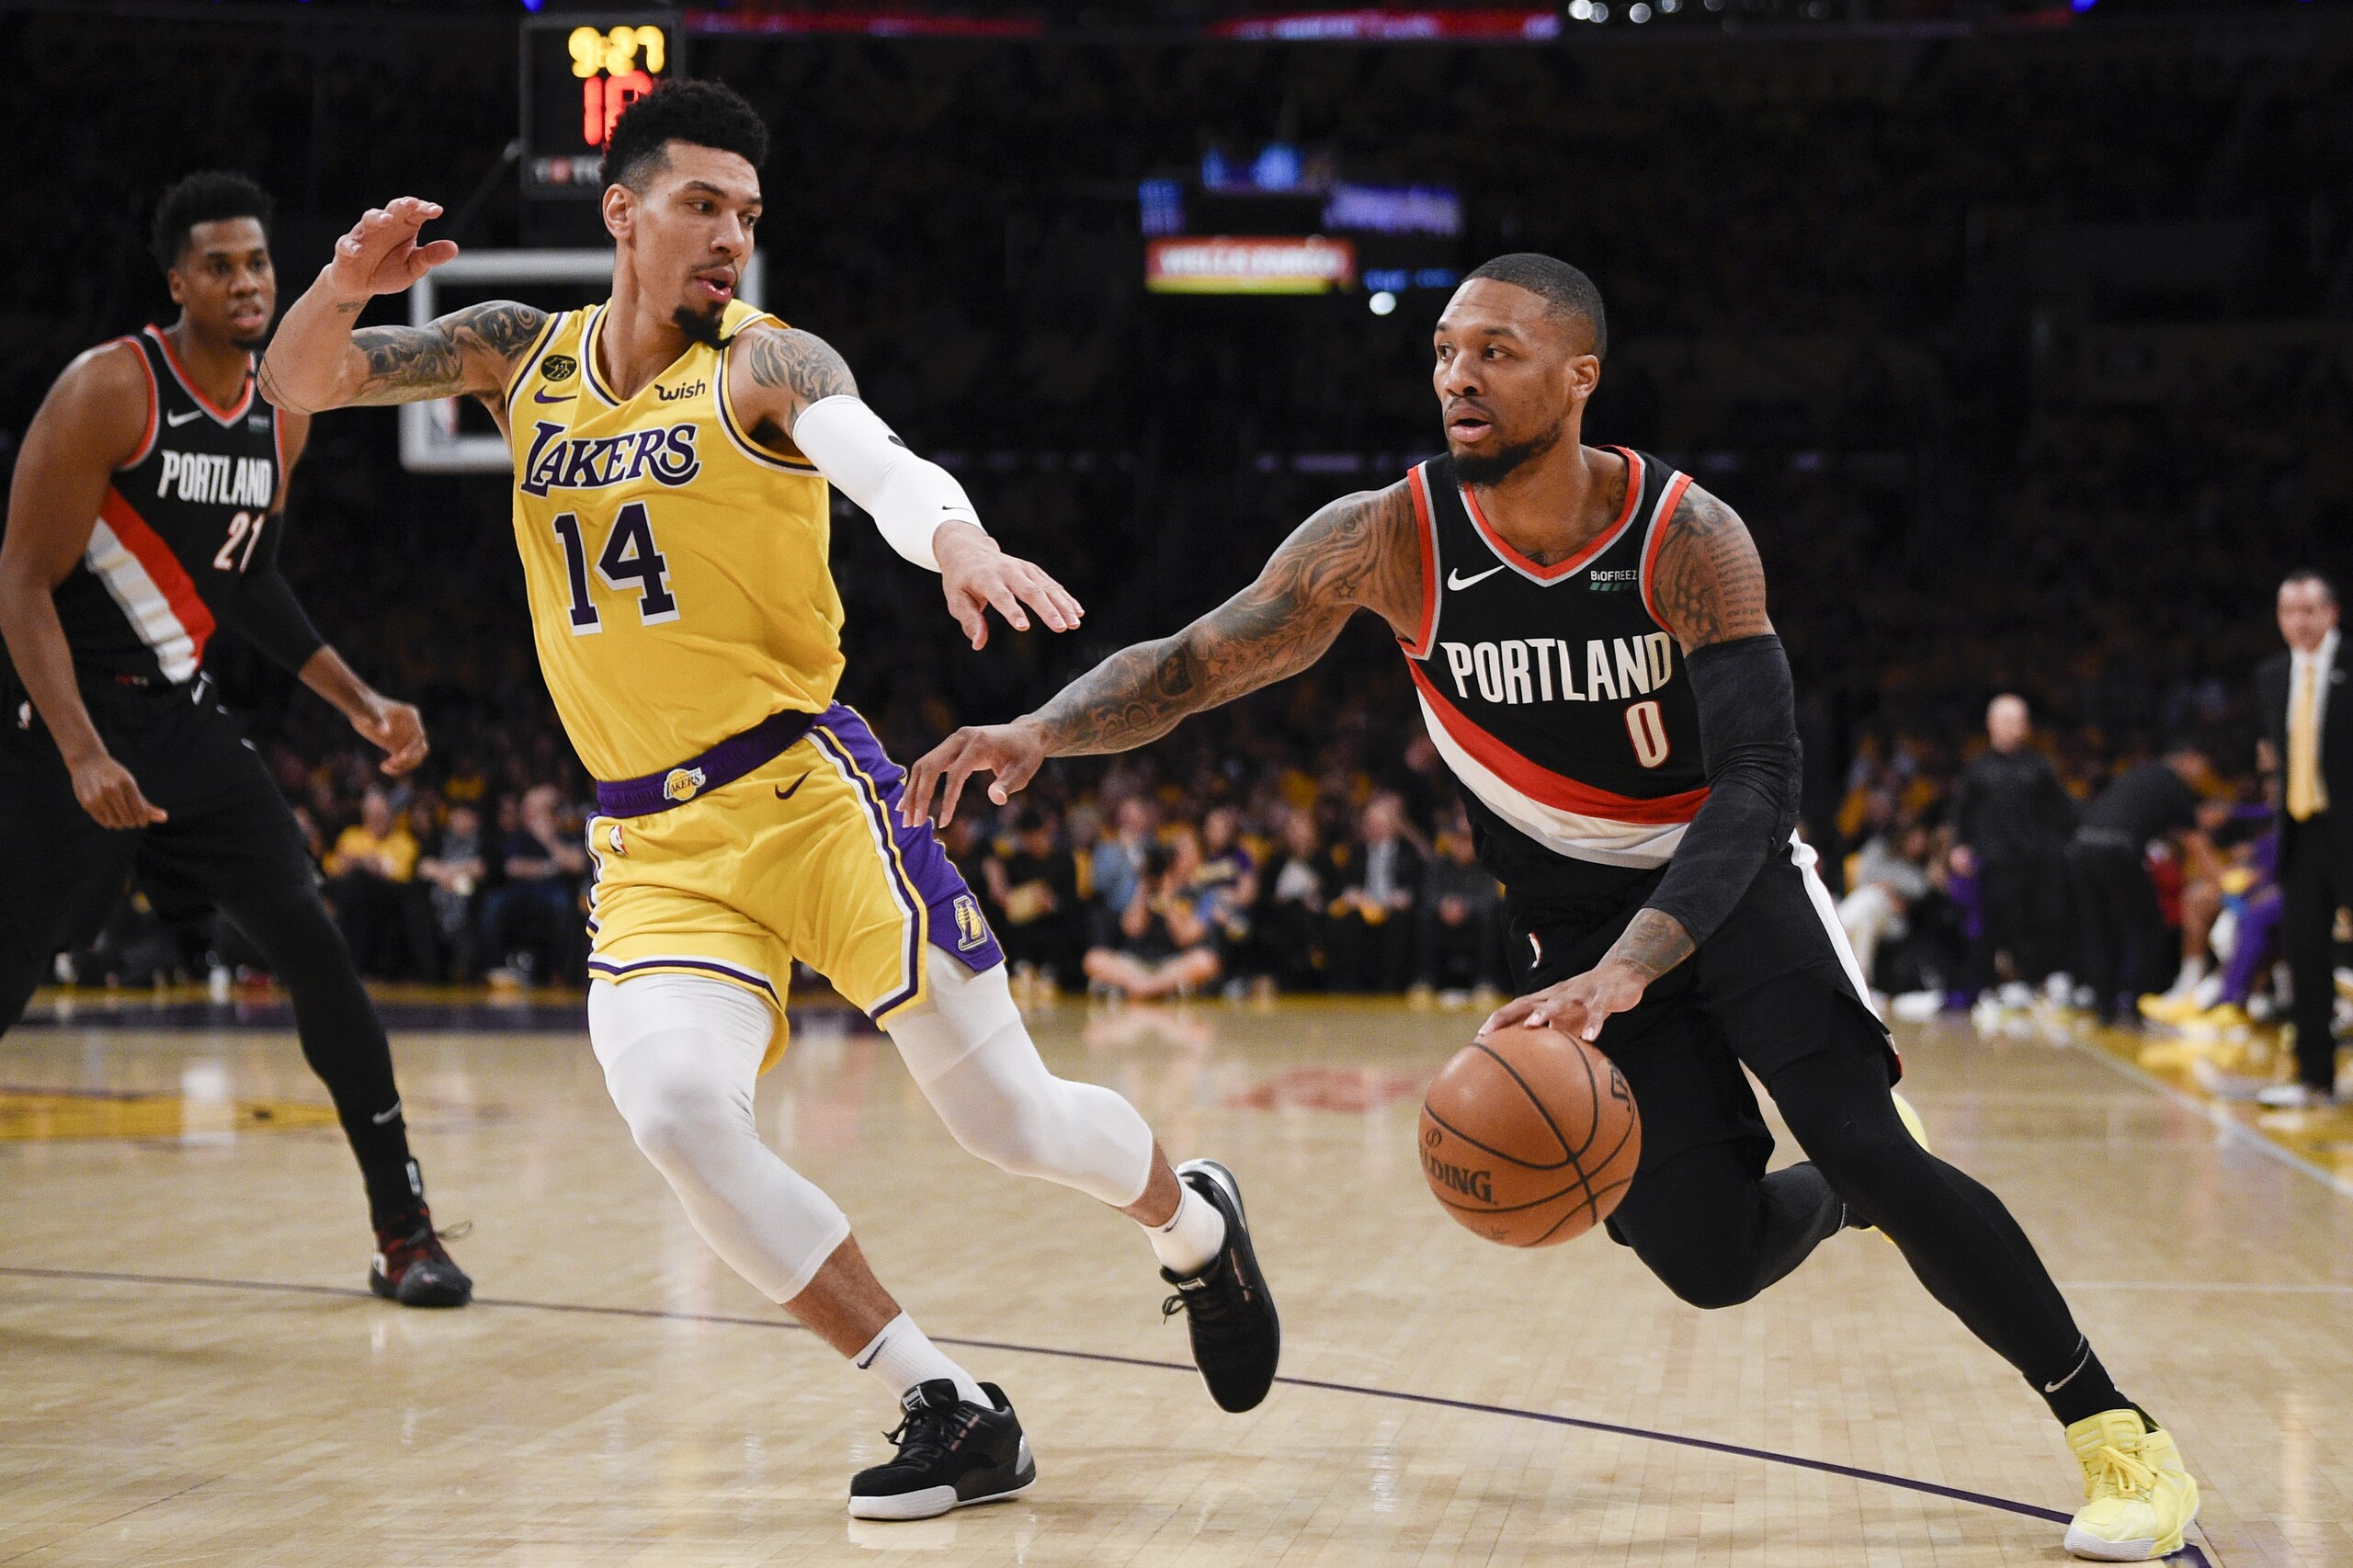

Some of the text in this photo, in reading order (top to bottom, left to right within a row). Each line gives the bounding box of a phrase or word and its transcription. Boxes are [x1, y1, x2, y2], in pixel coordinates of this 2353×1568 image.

[654, 379, 706, 402] wish
[156, 449, 273, 508] PORTLAND
[519, 419, 701, 500] LAKERS
[211, 510, 267, 574] 21
[552, 500, 681, 638] 14
[1438, 631, 1673, 705] PORTLAND
[1623, 699, 1671, 768] 0
